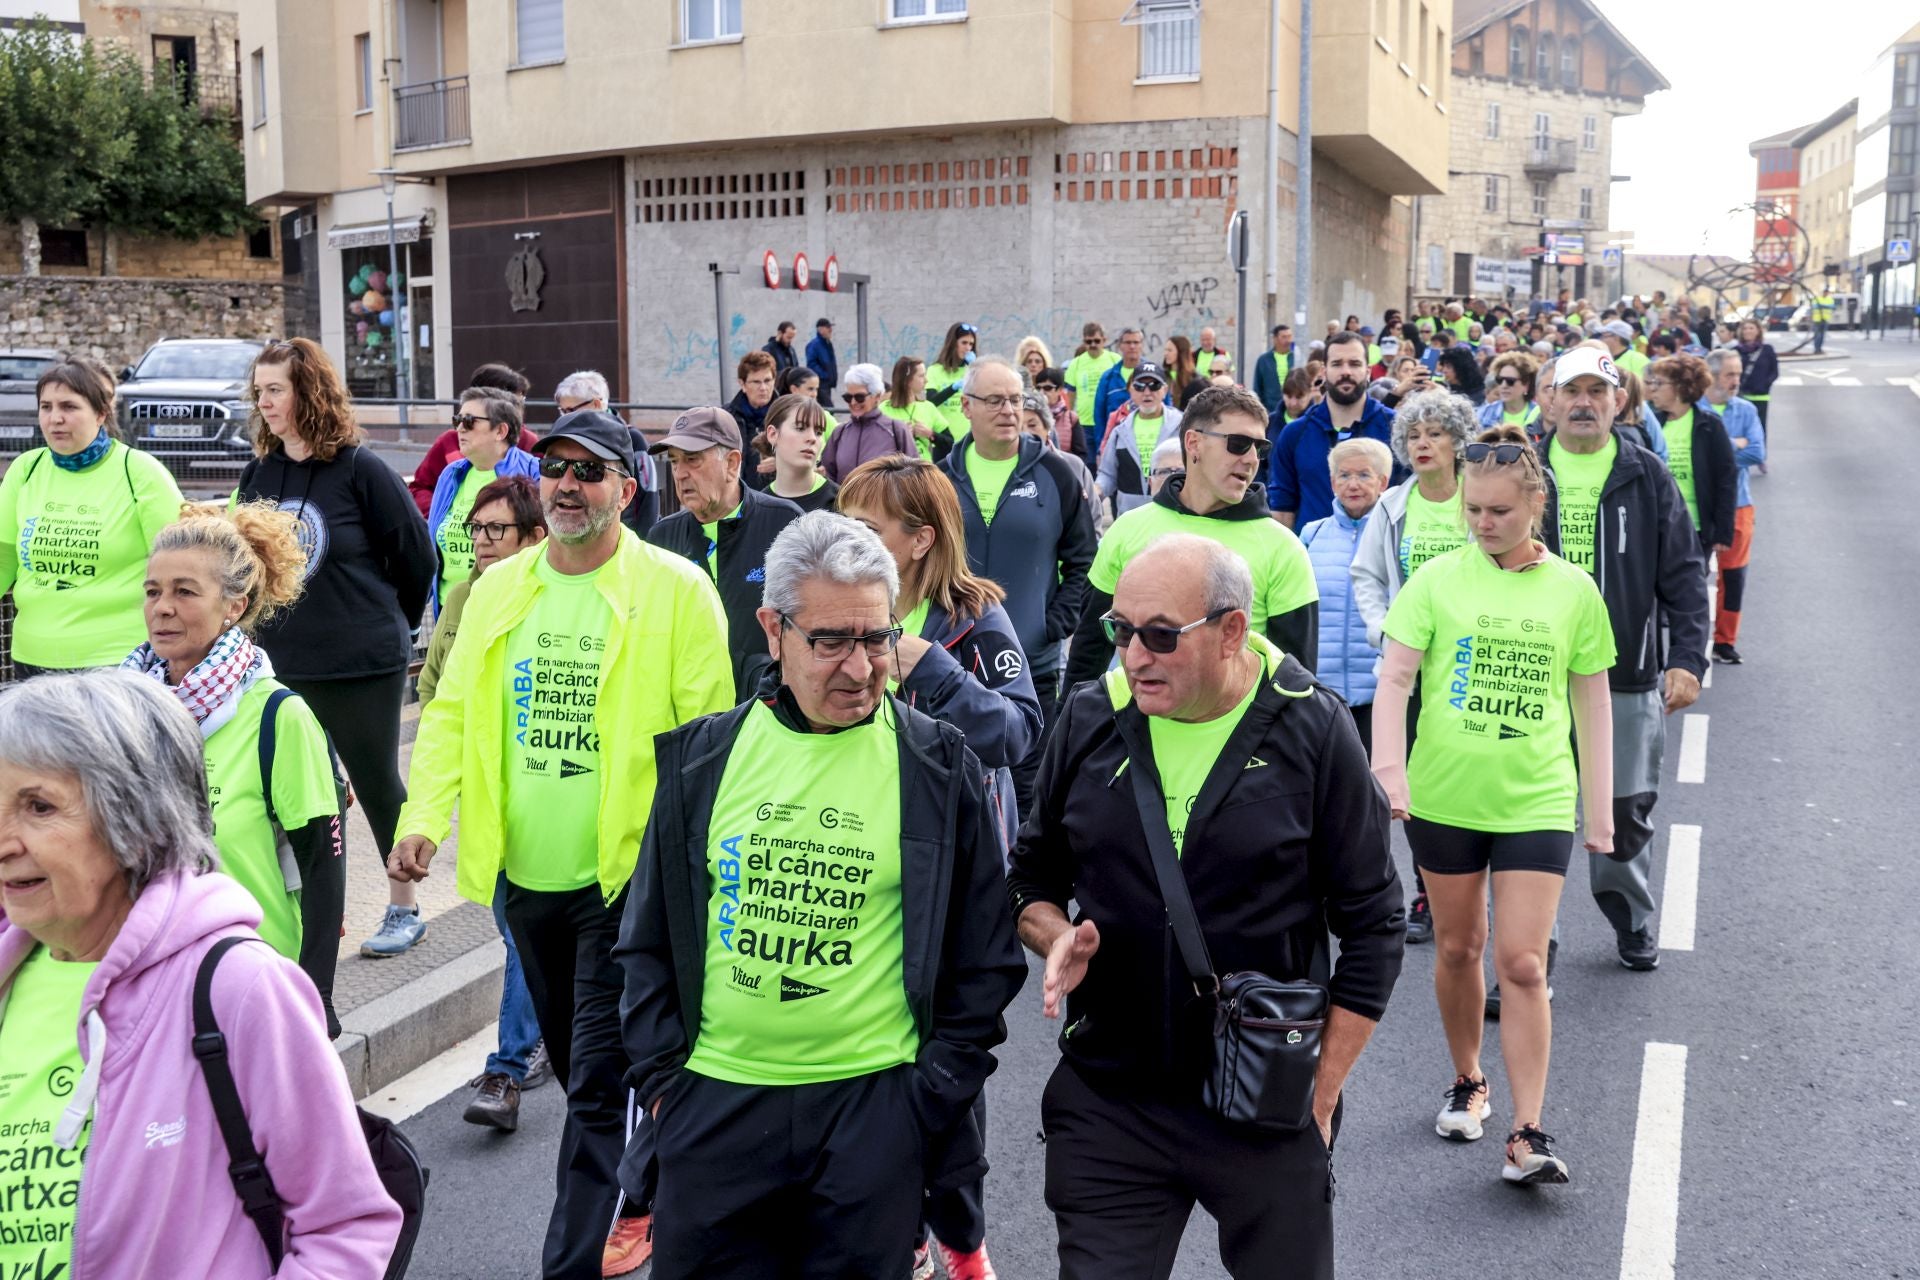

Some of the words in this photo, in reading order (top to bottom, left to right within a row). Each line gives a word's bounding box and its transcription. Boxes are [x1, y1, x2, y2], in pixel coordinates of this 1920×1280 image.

[38, 524, 50, 534] el
[54, 525, 101, 537] cáncer
[21, 516, 39, 572] ARABA
[32, 548, 99, 560] minbiziaren
[34, 537, 99, 550] martxan
[35, 560, 96, 576] aurka
[1477, 635, 1489, 644] En
[1491, 638, 1526, 648] marcha
[1477, 645, 1492, 659] el
[536, 657, 550, 666] En
[1449, 636, 1473, 710] ARABA
[1475, 662, 1550, 683] martxan
[536, 668, 551, 684] el
[1472, 678, 1548, 697] minbiziaren
[514, 657, 532, 746] ARABA
[1468, 695, 1544, 721] aurka
[533, 706, 595, 723] minbiziar
[526, 757, 548, 771] Vital
[750, 834, 767, 847] En
[770, 837, 824, 854] marcha
[828, 845, 875, 861] contra
[747, 849, 772, 871] el
[778, 854, 873, 885] cáncer
[718, 834, 744, 951] ARABA
[747, 876, 866, 910] martxan
[740, 901, 858, 930] minbiziaren
[738, 928, 853, 966] aurka
[732, 965, 761, 990] Vital
[0, 1175, 80, 1212] rtxa
